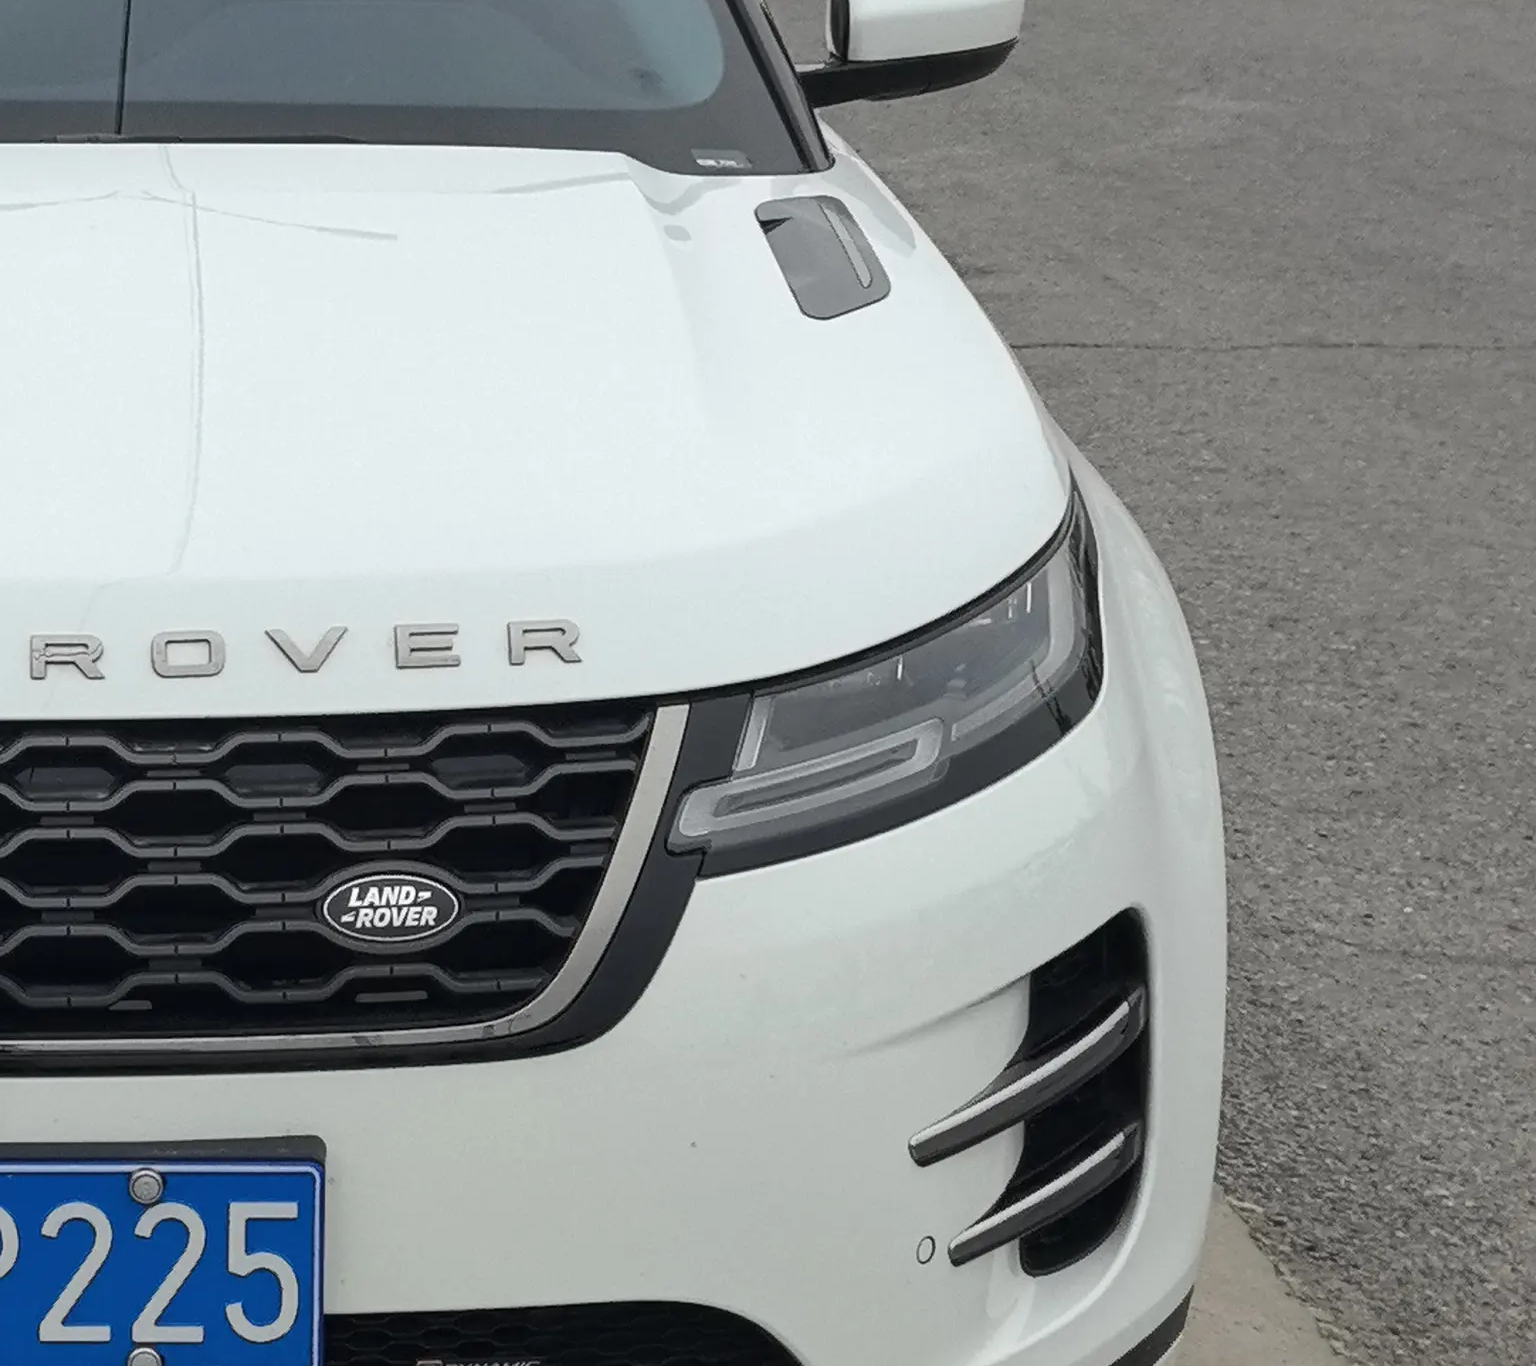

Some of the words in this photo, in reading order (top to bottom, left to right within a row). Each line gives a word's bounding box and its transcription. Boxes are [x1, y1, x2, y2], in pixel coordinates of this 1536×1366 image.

[28, 619, 583, 680] ROVER
[347, 885, 417, 907] LAND
[356, 906, 438, 928] ROVER
